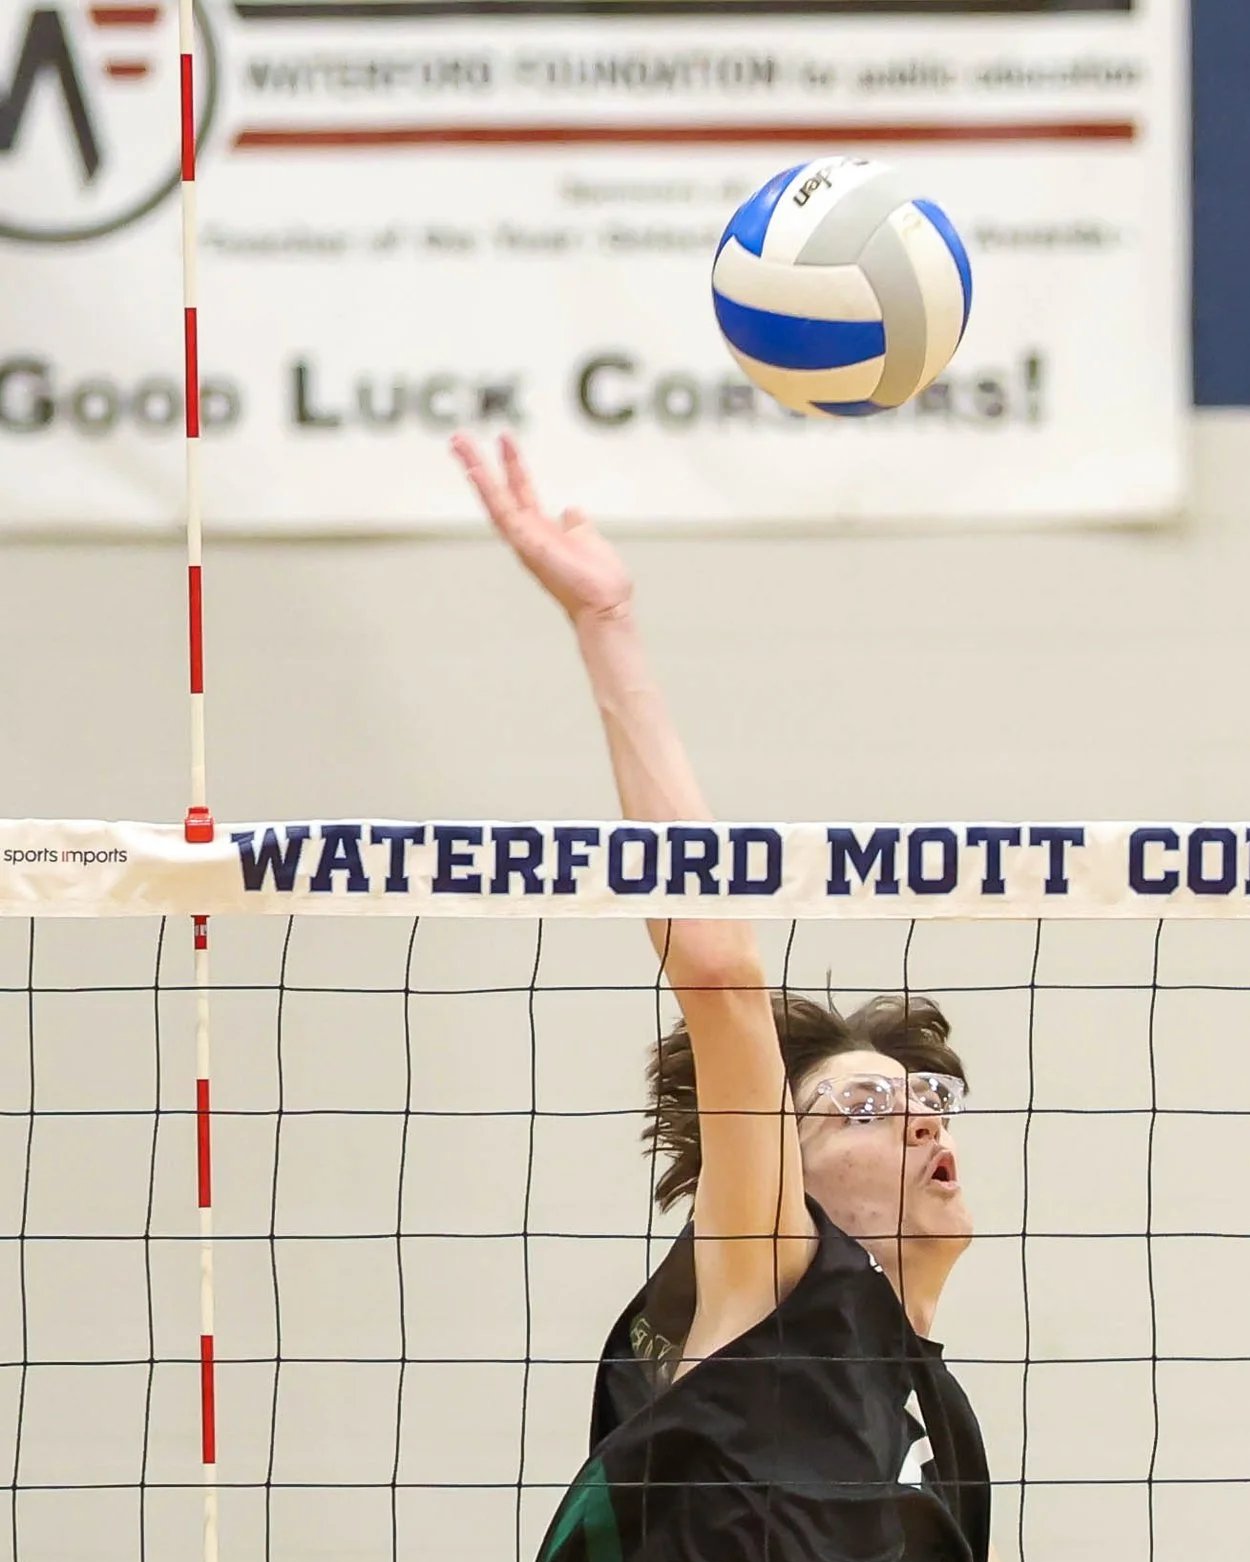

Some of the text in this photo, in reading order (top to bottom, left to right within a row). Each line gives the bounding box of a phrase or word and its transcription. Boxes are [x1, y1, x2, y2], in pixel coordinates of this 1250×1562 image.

[3, 847, 128, 867] sports imports
[230, 824, 783, 896] WATERFORD
[826, 826, 1085, 896] MOTT
